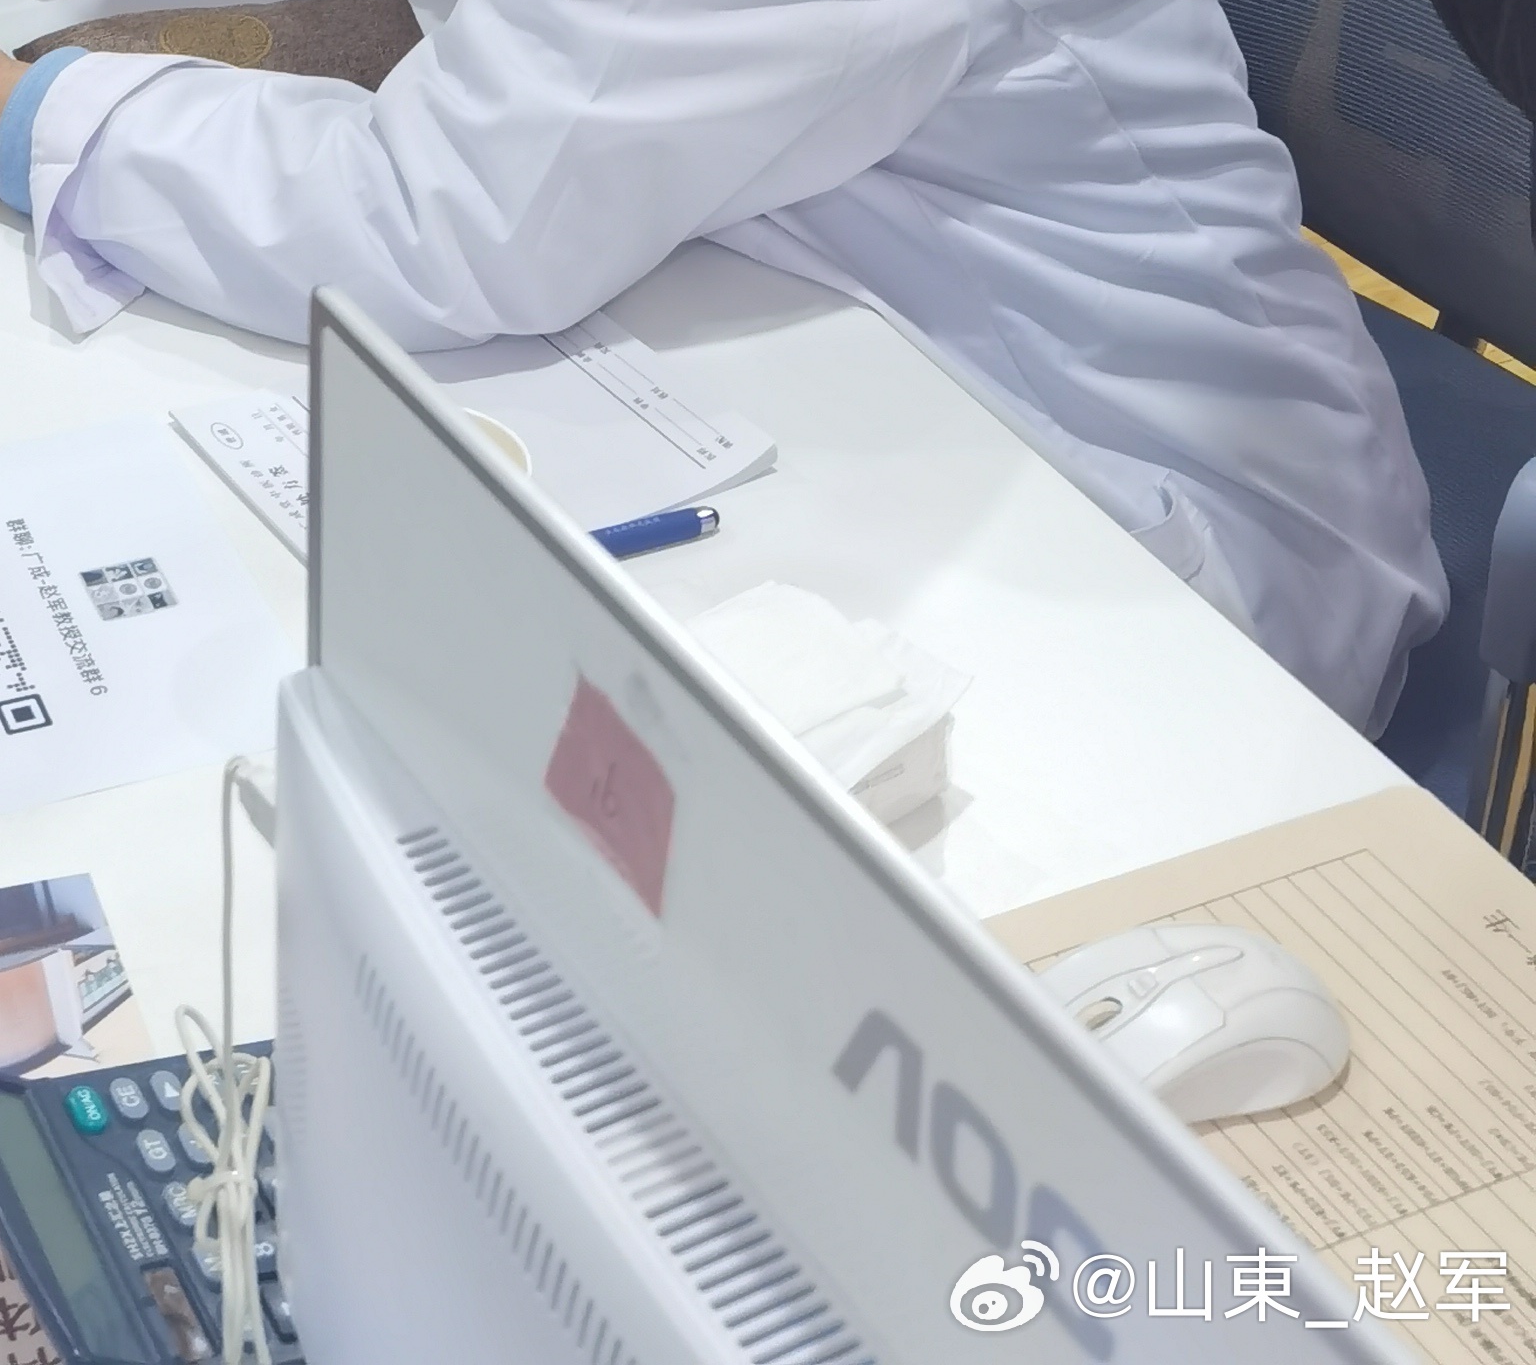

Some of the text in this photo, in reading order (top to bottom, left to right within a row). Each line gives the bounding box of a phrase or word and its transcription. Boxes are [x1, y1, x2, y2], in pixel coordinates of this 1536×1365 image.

[77, 1088, 101, 1121] ON/AC
[115, 1086, 140, 1108] CE
[143, 1139, 167, 1160] GT
